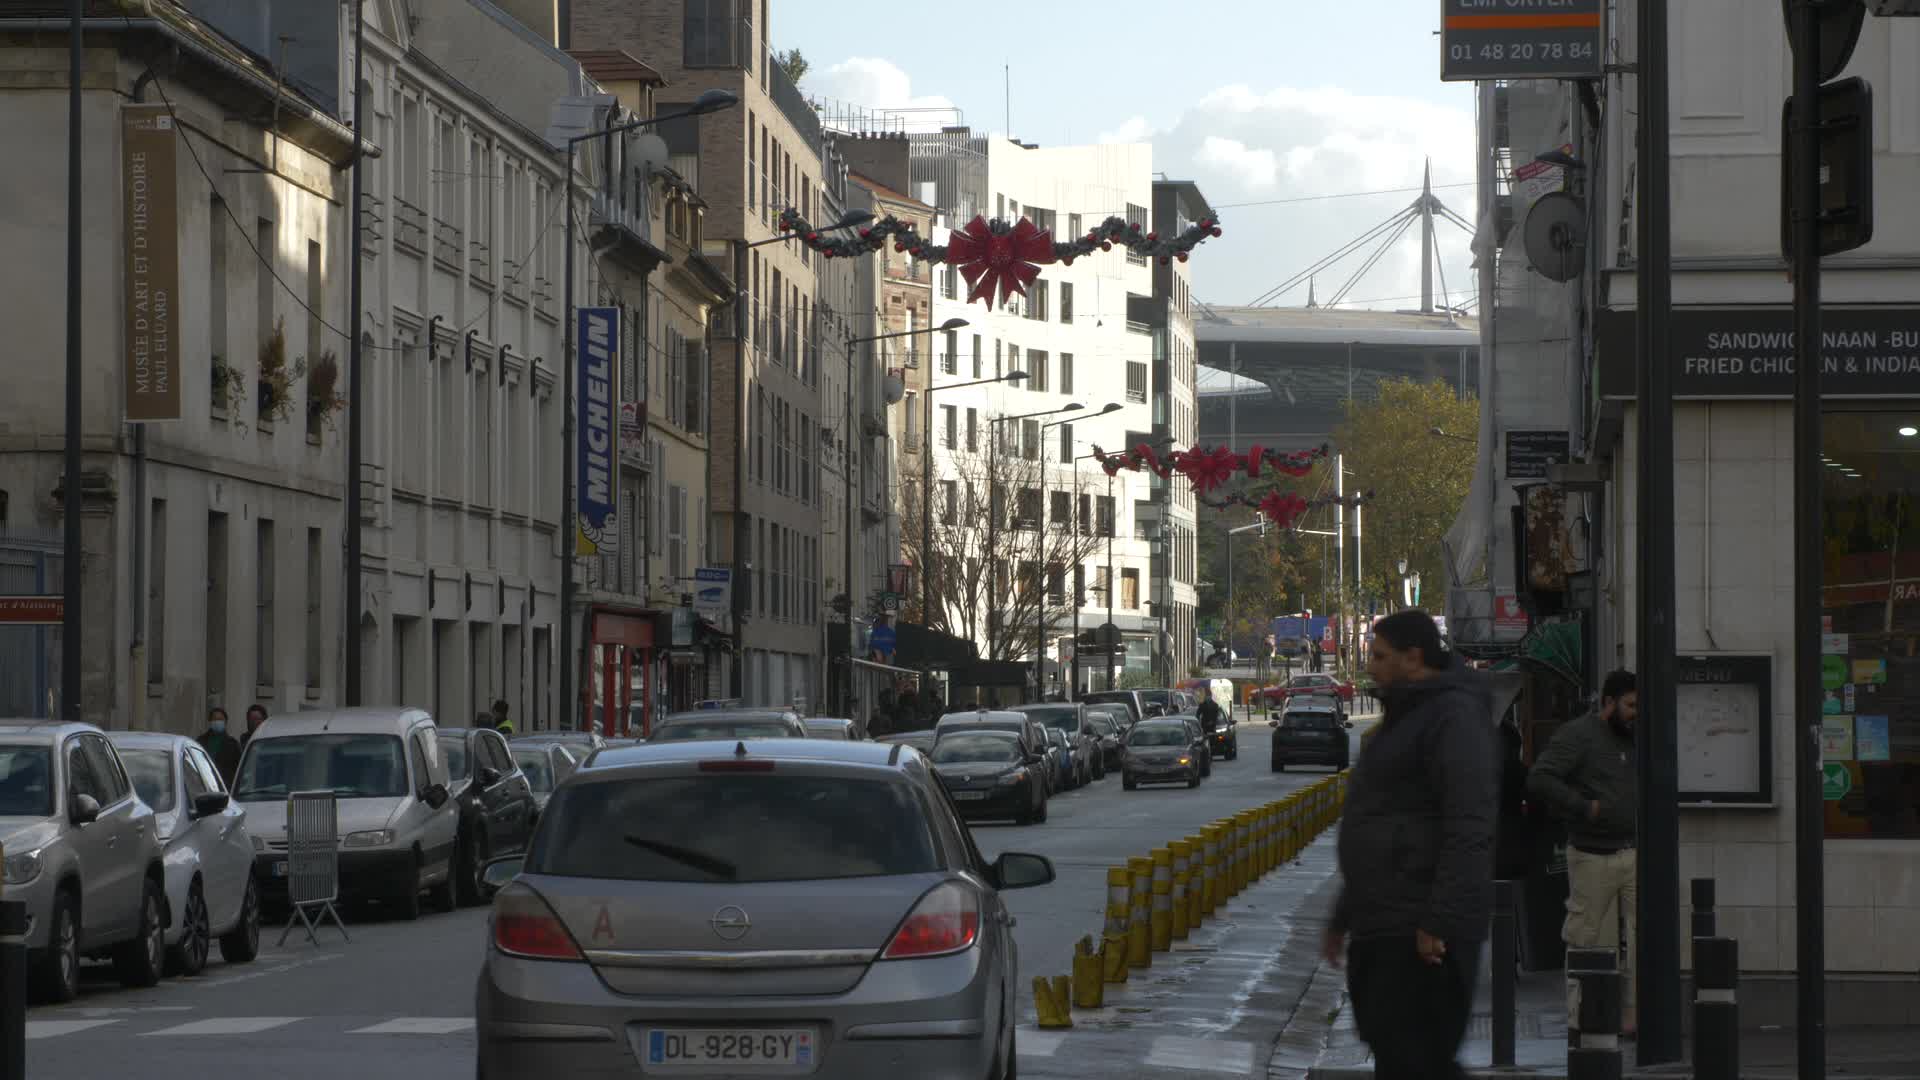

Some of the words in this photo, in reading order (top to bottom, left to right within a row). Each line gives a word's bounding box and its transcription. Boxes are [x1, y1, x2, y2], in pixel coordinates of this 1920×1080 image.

[1450, 44, 1473, 60] 01
[1479, 44, 1504, 60] 48
[1510, 43, 1534, 59] 20
[1539, 43, 1563, 59] 78
[1569, 42, 1593, 59] 84
[132, 151, 148, 249] D'HISTOIRE
[134, 253, 148, 274] ET
[134, 279, 149, 330] D'ART
[1707, 332, 1797, 350] SANDWIC
[1822, 331, 1877, 348] NAAN
[132, 335, 149, 393] MUSÉE
[154, 355, 168, 393] PAUL
[1684, 357, 1744, 375] FRIED
[1749, 356, 1838, 374] CHICN
[1845, 355, 1857, 373] &
[587, 312, 609, 505] MICHELIN
[591, 903, 616, 943] A
[665, 1035, 793, 1059] DL-928-GY
